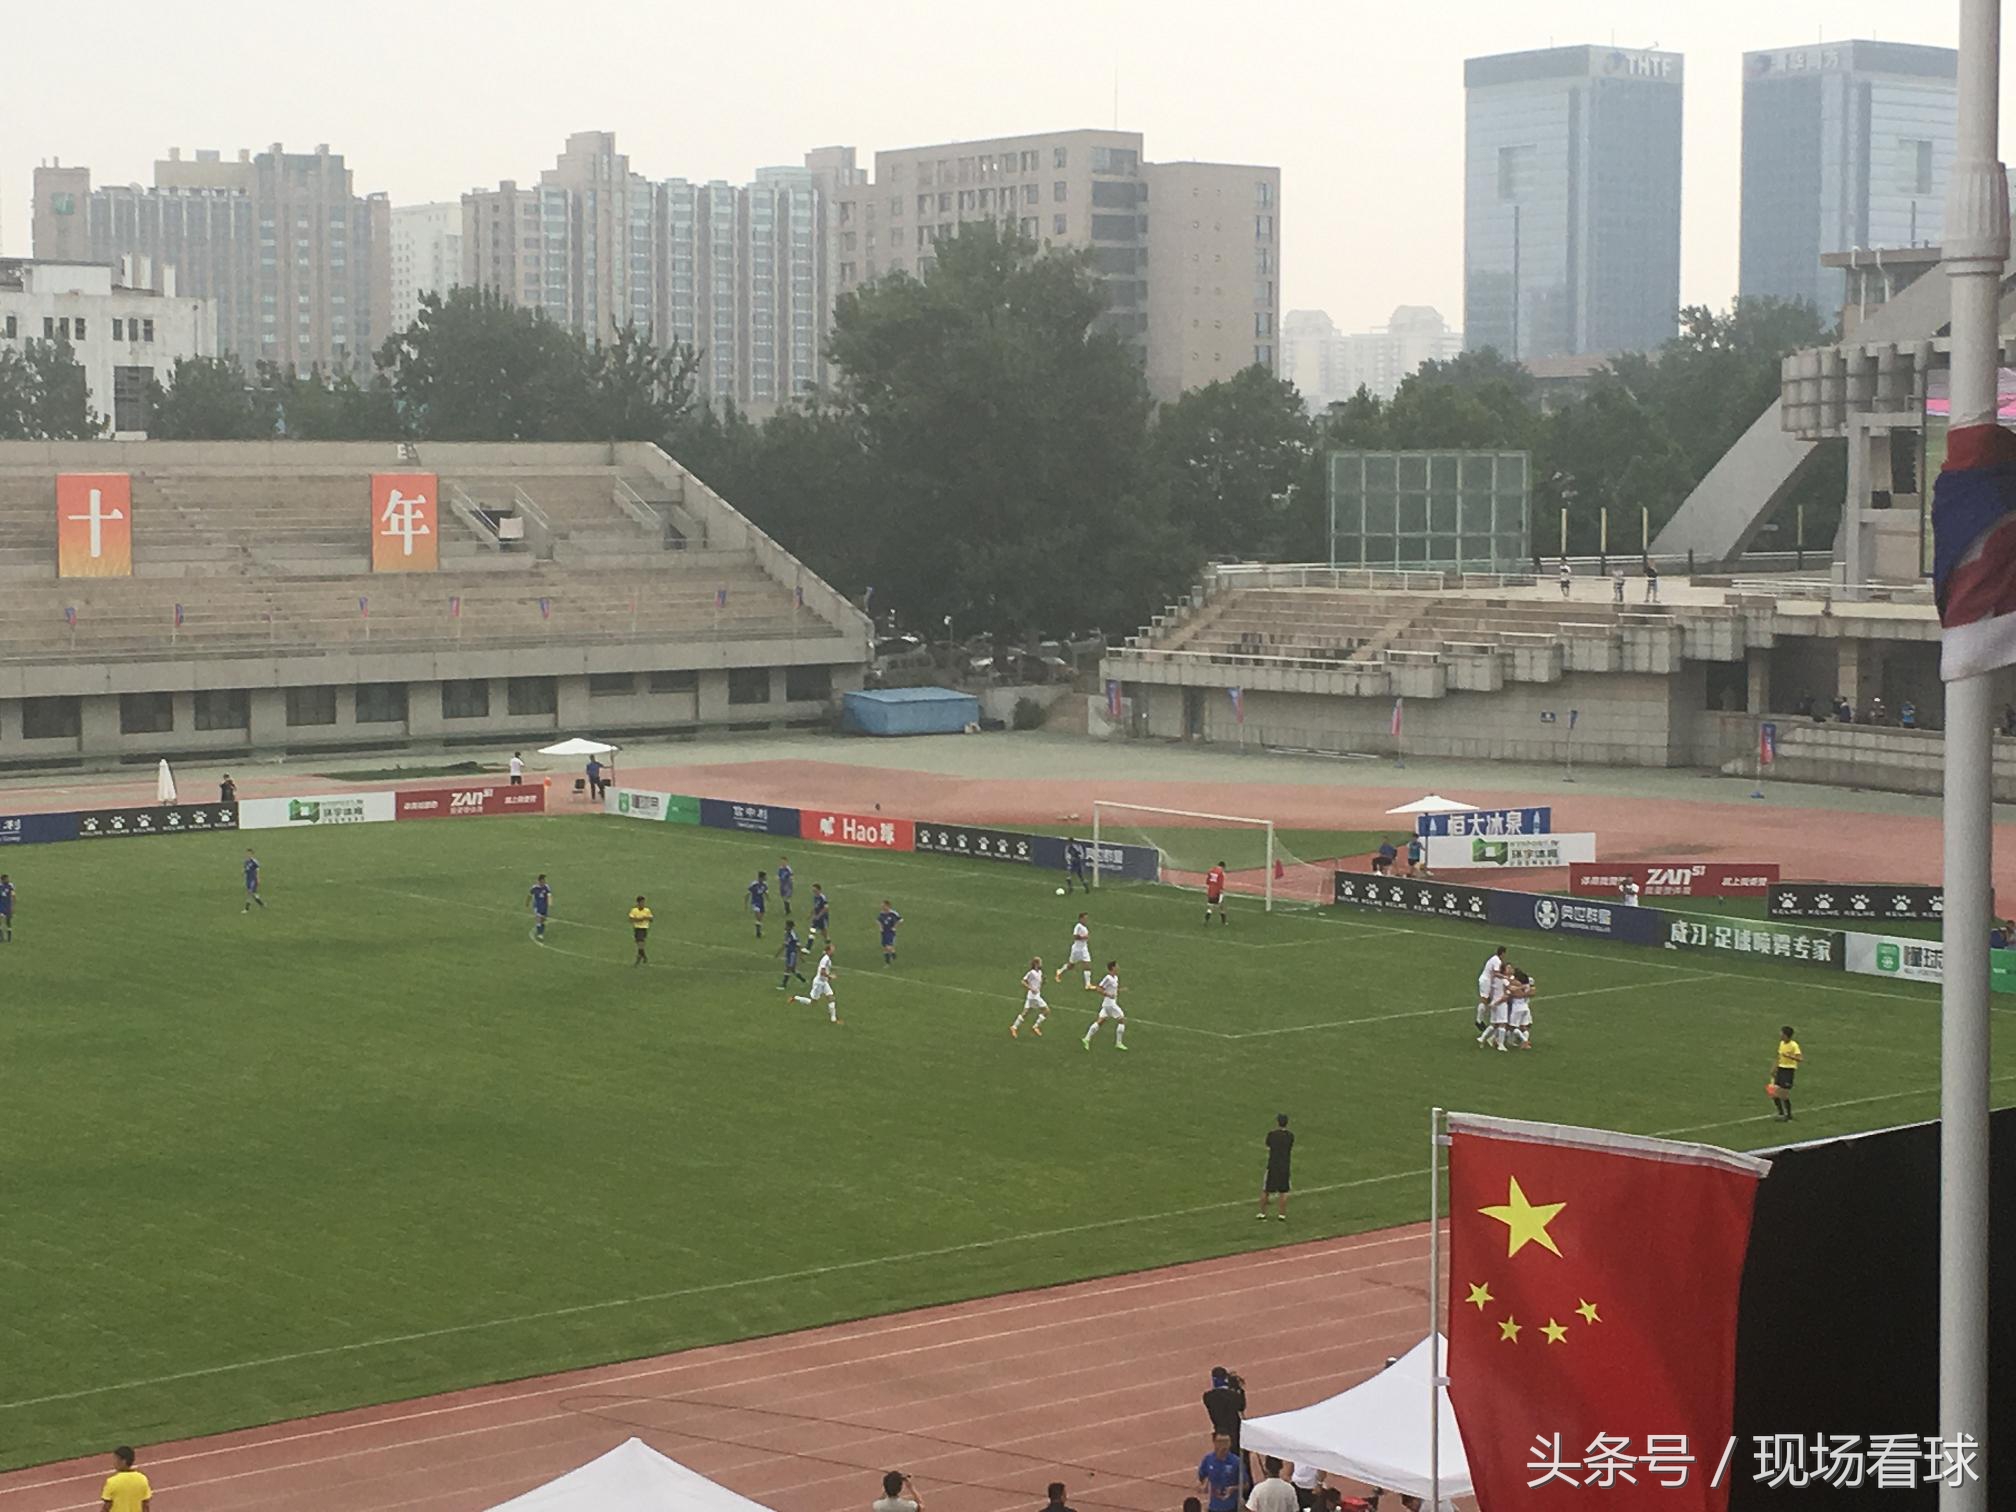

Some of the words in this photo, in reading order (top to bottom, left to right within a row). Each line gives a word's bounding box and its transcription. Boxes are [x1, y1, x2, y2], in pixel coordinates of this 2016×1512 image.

[1626, 55, 1673, 77] THTF
[68, 489, 124, 558] 十
[380, 489, 430, 556] 年
[1448, 811, 1523, 836] 恒大冰泉
